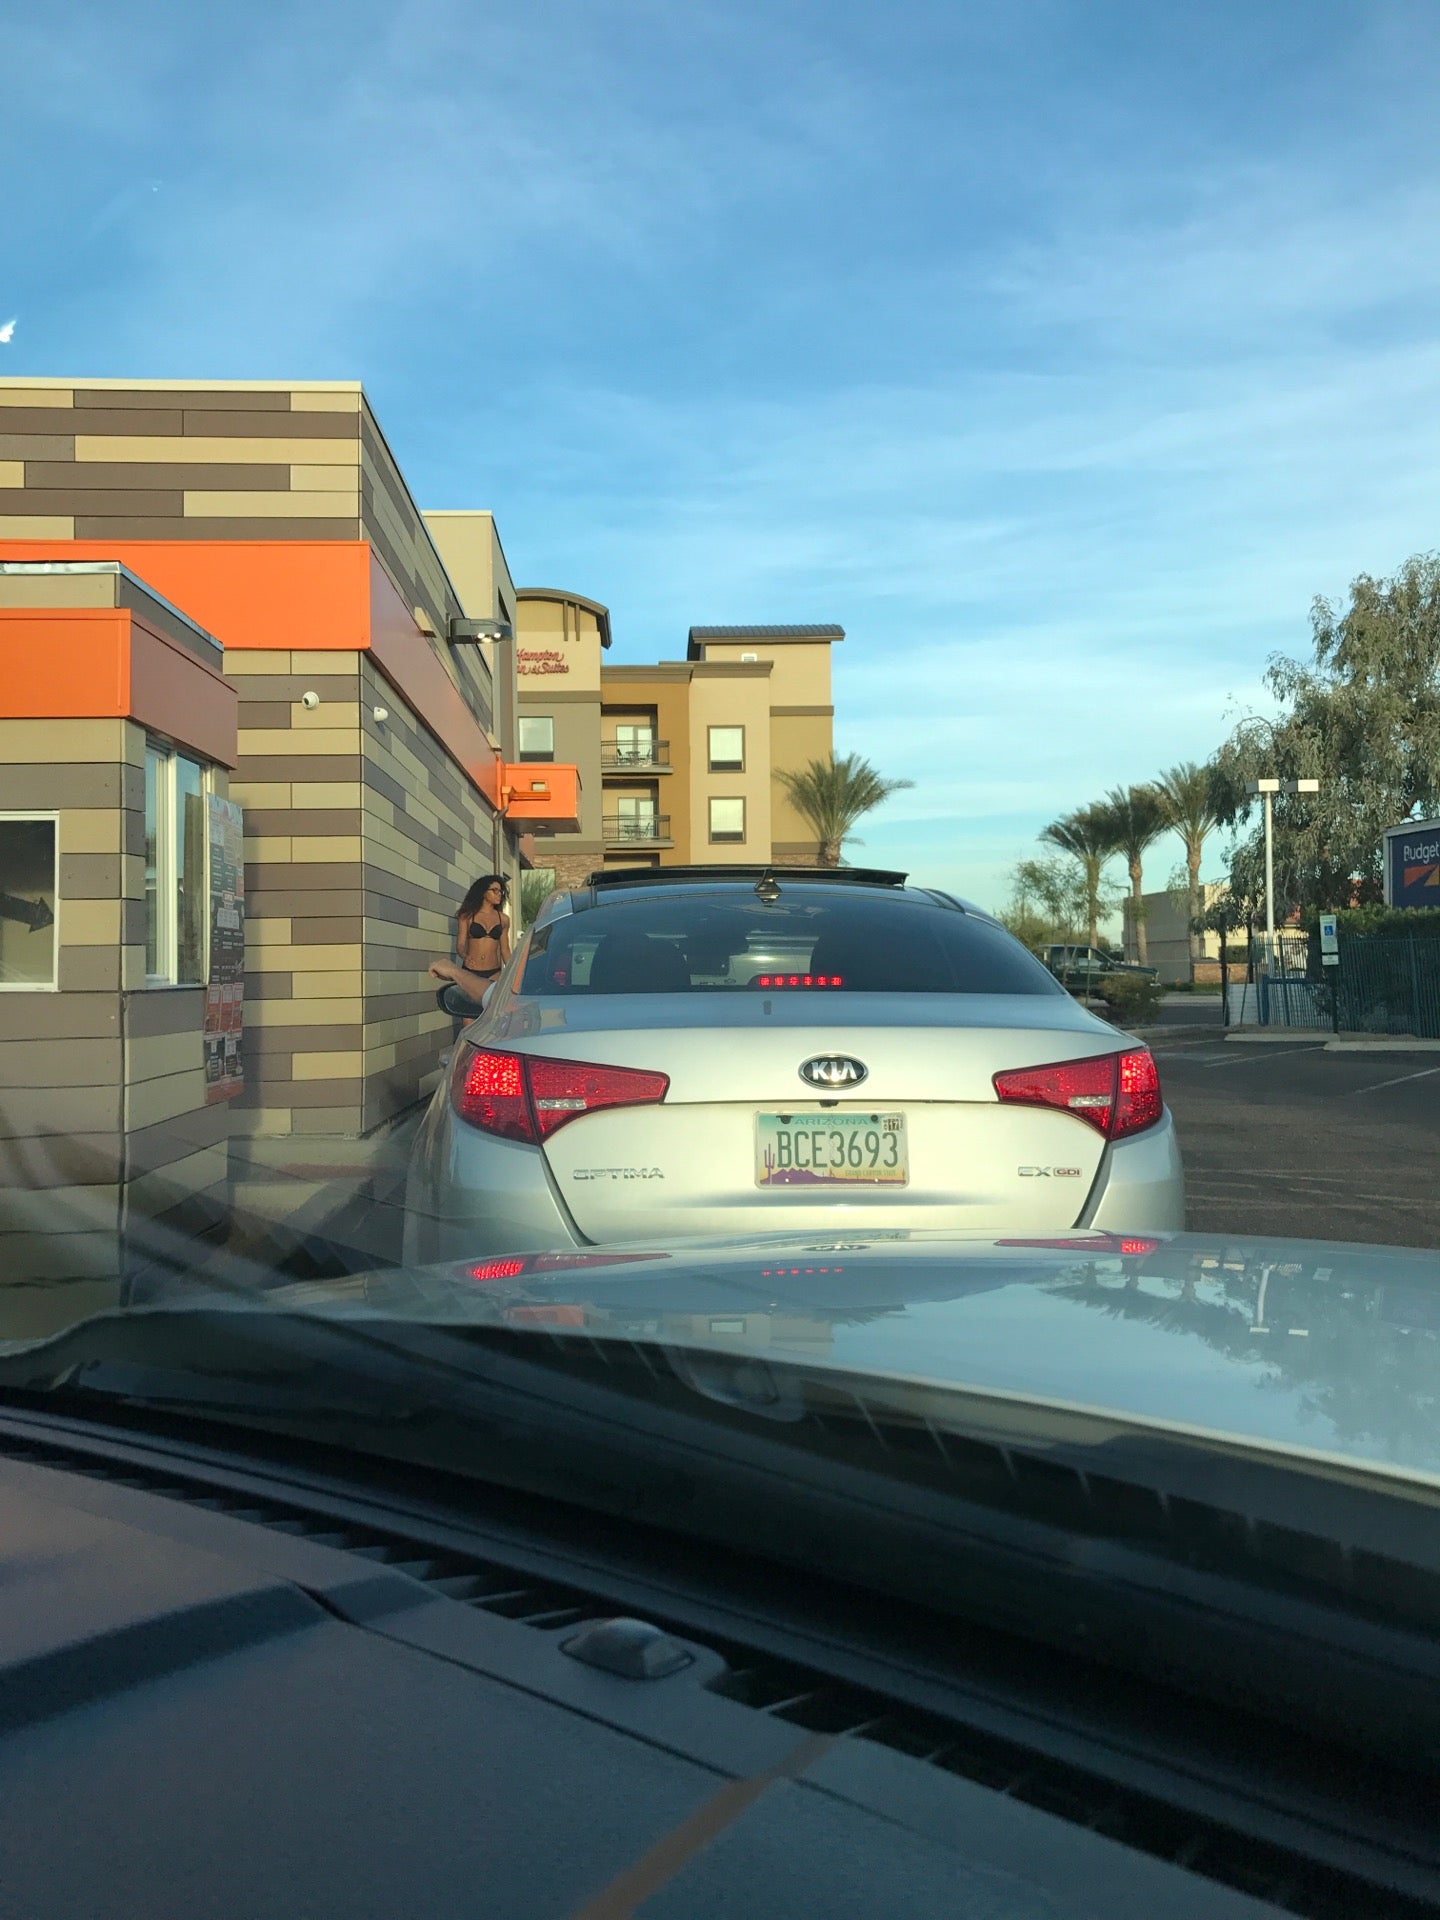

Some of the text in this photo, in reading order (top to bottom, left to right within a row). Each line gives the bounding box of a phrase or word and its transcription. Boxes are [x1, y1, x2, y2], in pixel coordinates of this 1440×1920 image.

[1403, 841, 1440, 864] Budget
[811, 1062, 858, 1080] KIA
[794, 1118, 869, 1126] ARIZONA
[776, 1130, 898, 1168] BCE3693
[573, 1168, 664, 1180] OPTIMA
[1018, 1166, 1051, 1177] EX
